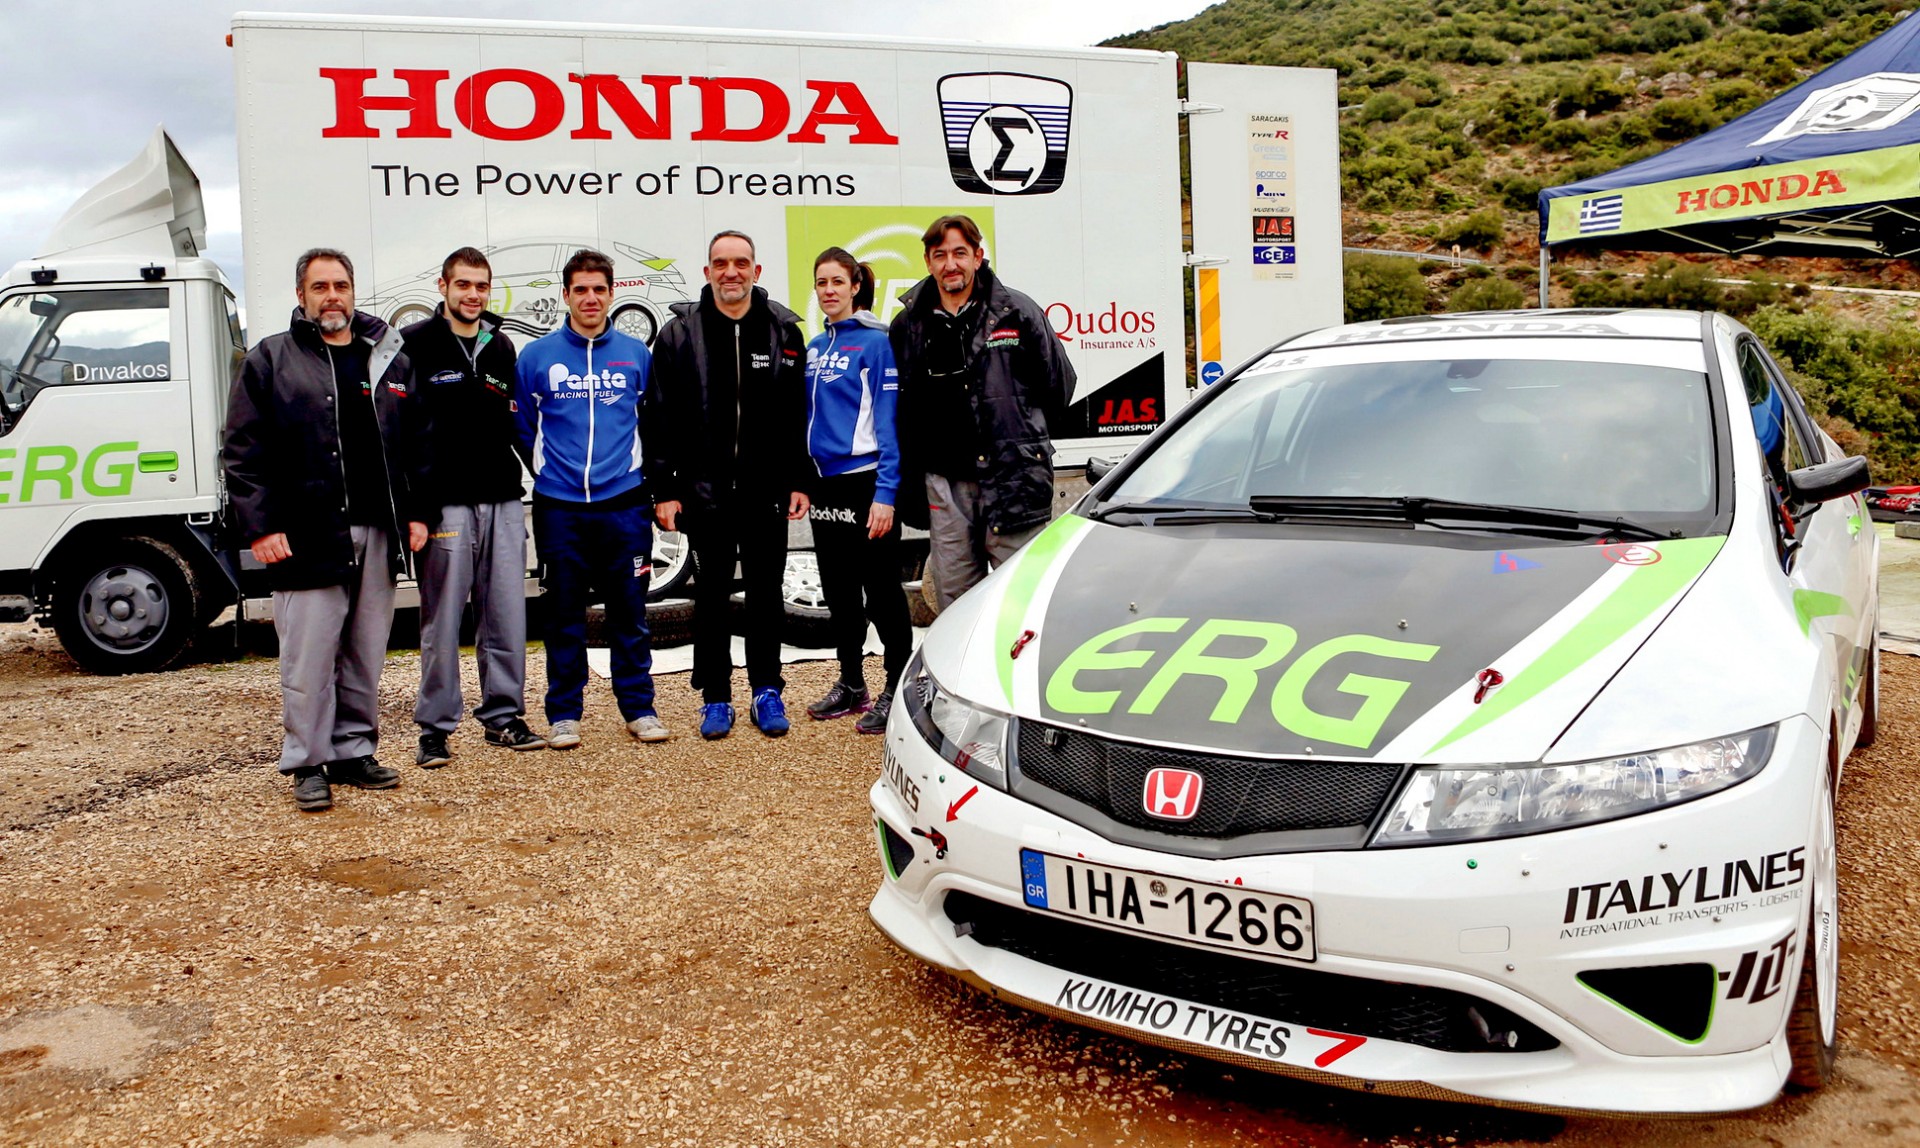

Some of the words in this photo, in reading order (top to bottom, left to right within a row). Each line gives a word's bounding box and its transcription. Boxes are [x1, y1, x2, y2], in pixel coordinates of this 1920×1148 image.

[319, 67, 899, 145] HONDA
[1275, 130, 1289, 140] R
[1253, 144, 1286, 152] Greece
[371, 164, 459, 197] The
[476, 164, 623, 197] Power
[635, 165, 681, 196] of
[696, 165, 856, 197] Dreams
[1675, 169, 1847, 215] HONDA
[1045, 302, 1156, 342] Qudos
[1329, 322, 1630, 344] HONDA
[1080, 339, 1134, 350] Insurance
[1137, 337, 1156, 349] A/S
[751, 353, 770, 361] Team
[73, 361, 168, 381] Drivakos
[549, 363, 627, 391] Panta
[554, 391, 588, 399] RACING
[1098, 424, 1158, 433] MOTORSPORT
[1046, 617, 1441, 749] ERG
[1027, 883, 1045, 900] GR
[1066, 865, 1304, 952] IHA-1266
[1560, 916, 1662, 940] INTERNATIONAL
[1668, 901, 1749, 924] TRANSPORTS
[1055, 978, 1179, 1030] KUMHO
[1183, 1005, 1291, 1059] TYRES
